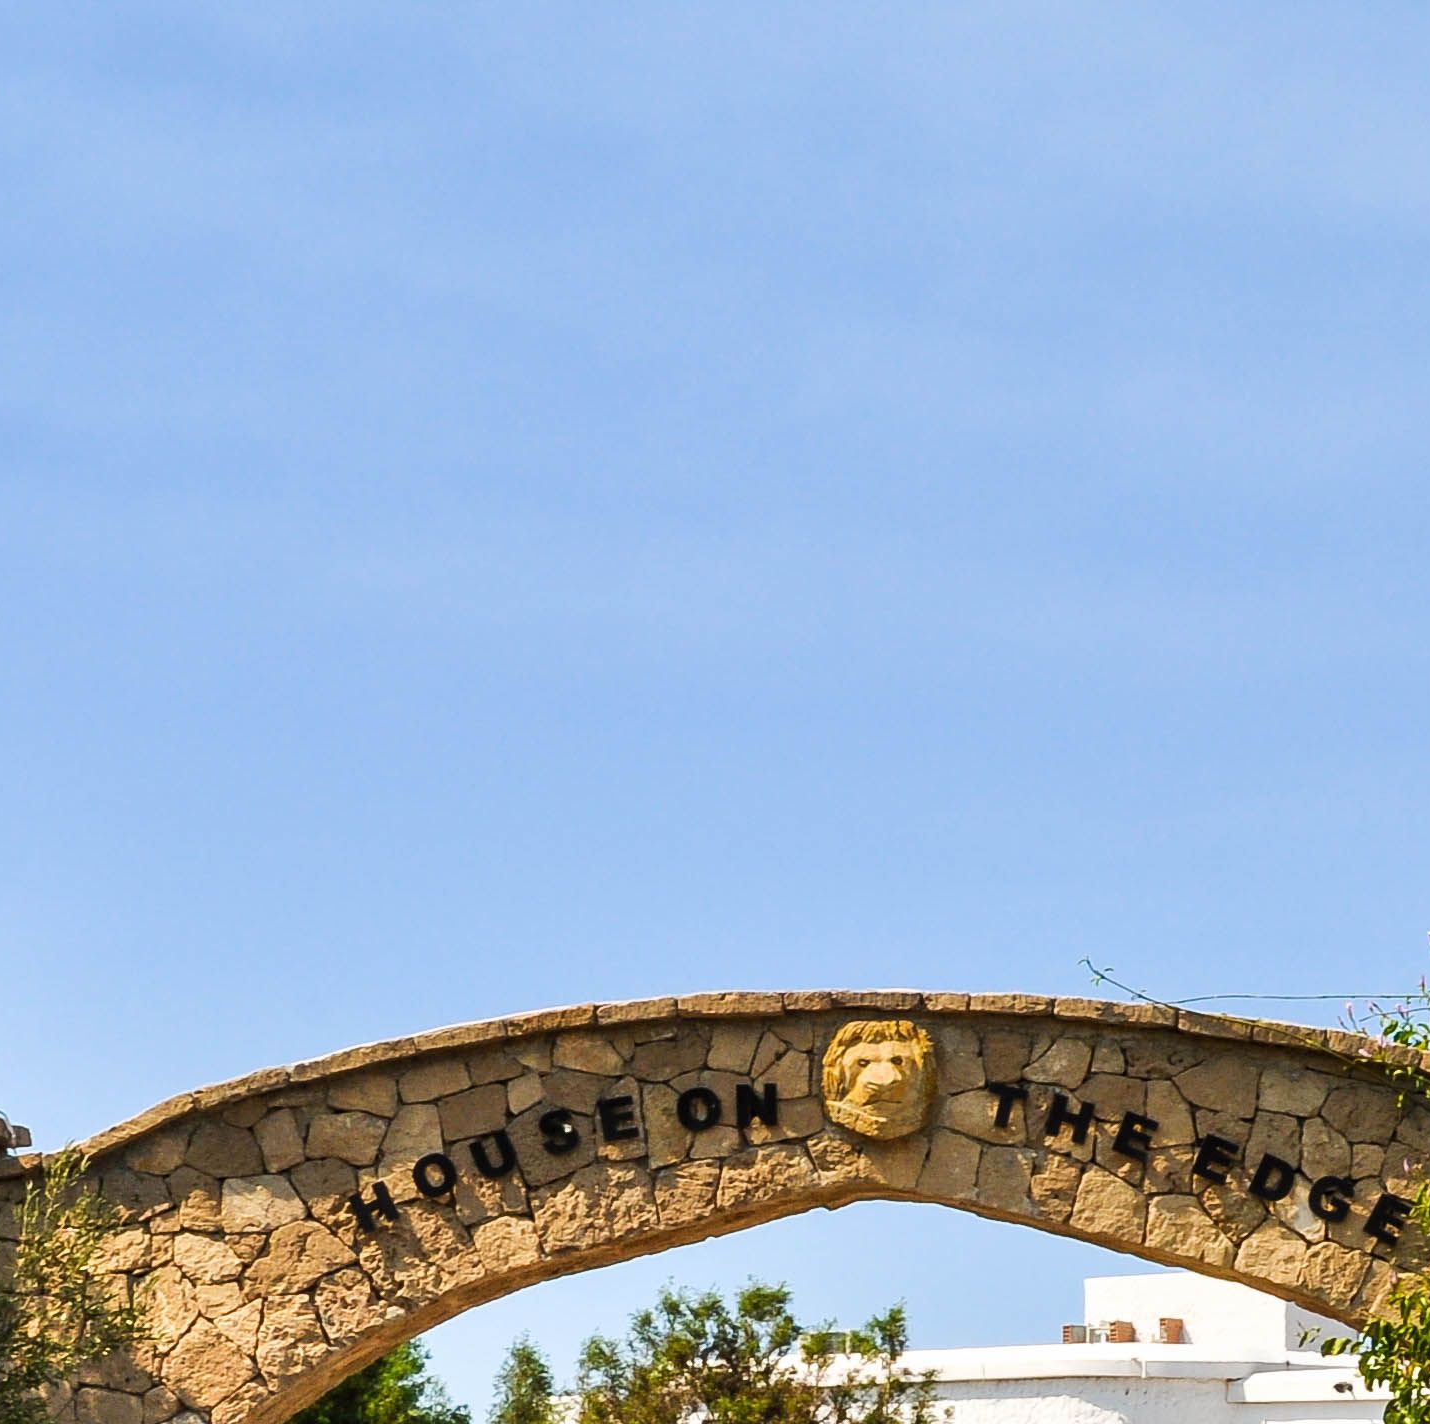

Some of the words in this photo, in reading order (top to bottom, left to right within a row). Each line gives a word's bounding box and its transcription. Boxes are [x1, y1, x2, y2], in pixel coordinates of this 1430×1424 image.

[350, 1095, 640, 1232] HOUSE
[676, 1082, 779, 1133] ON
[988, 1082, 1159, 1156] THE
[1192, 1133, 1417, 1246] EDGE
